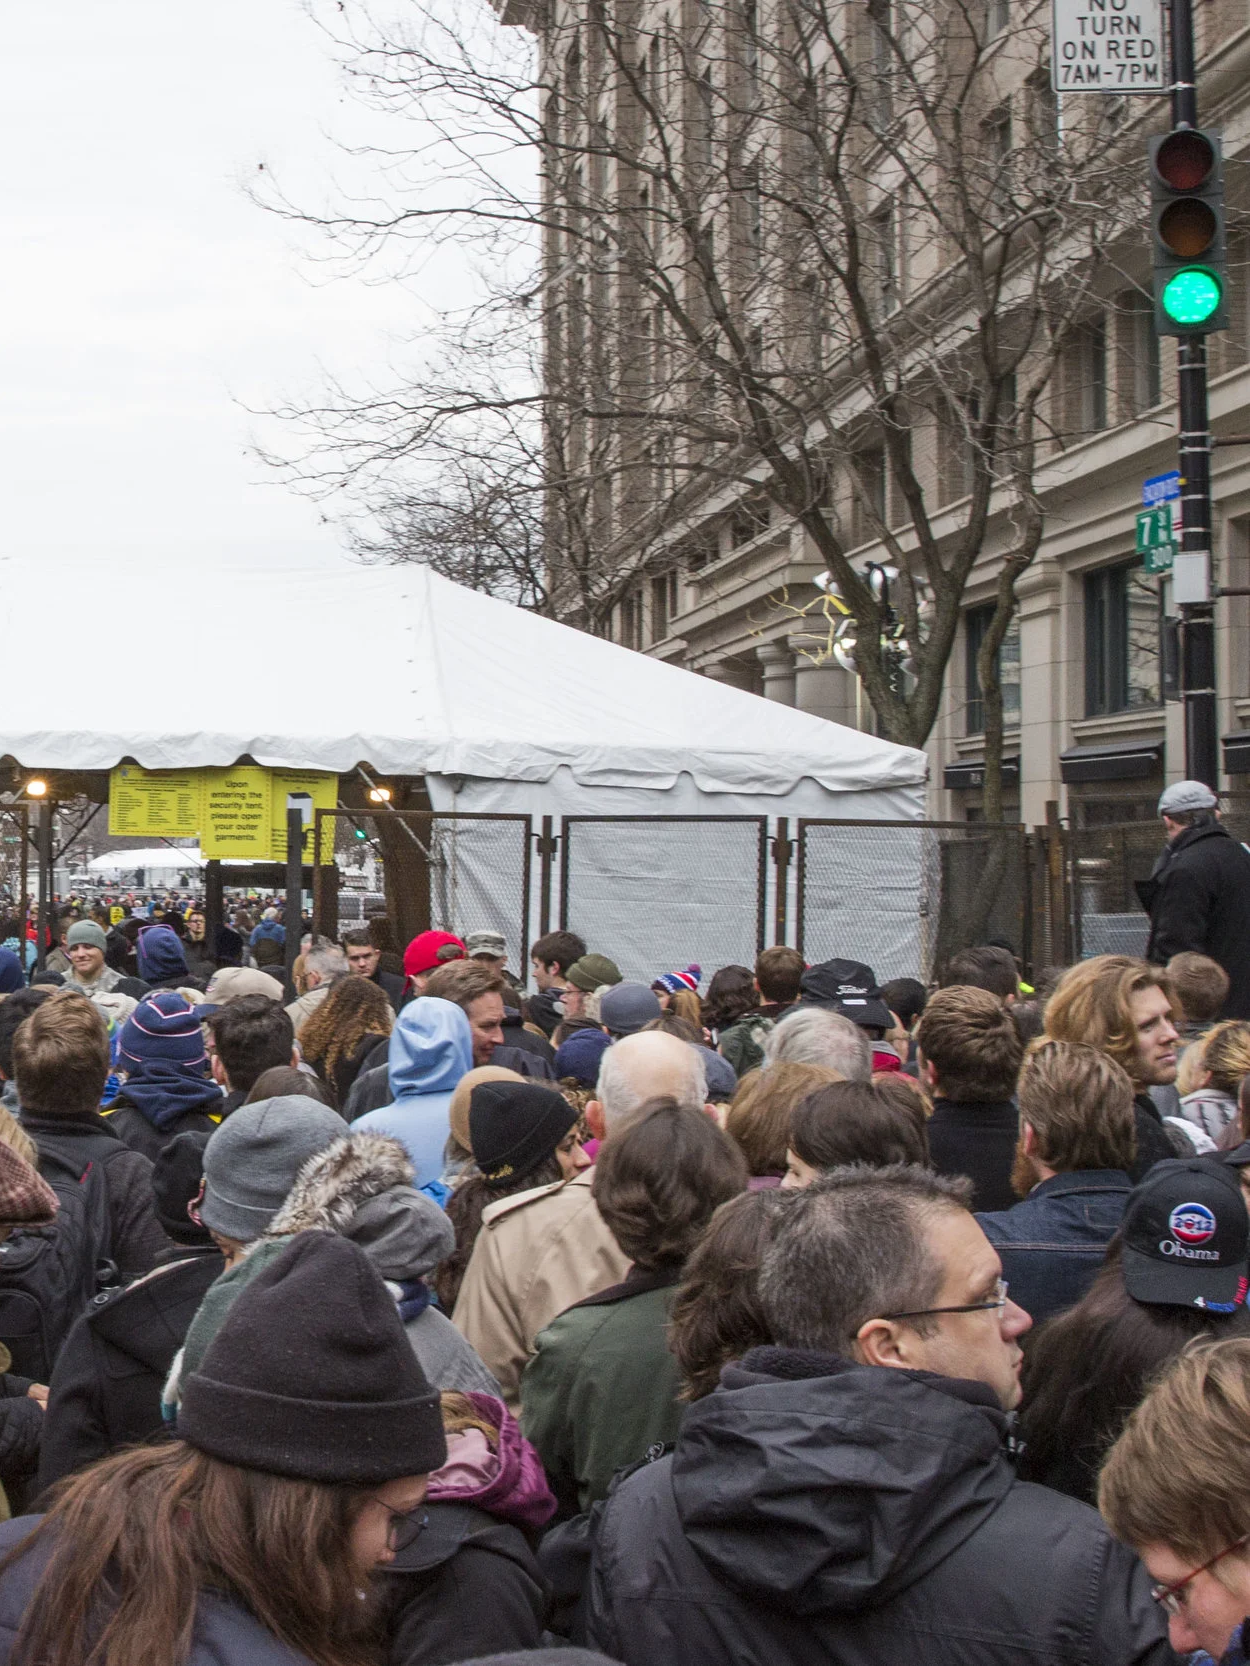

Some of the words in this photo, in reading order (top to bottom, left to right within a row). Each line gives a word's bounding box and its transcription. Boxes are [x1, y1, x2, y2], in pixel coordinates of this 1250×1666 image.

[1076, 15, 1141, 36] TURN
[1062, 40, 1096, 60] ON
[1106, 39, 1155, 59] RED
[1060, 63, 1158, 84] 7AM-7PM
[1140, 516, 1152, 546] 7
[225, 780, 249, 789] Upon
[211, 791, 246, 800] entering
[209, 801, 243, 810] security
[211, 812, 239, 820] please
[241, 813, 262, 821] open
[214, 823, 234, 831] your
[236, 823, 259, 831] outer
[214, 833, 257, 842] garments.
[1174, 1217, 1213, 1231] 2012
[1158, 1240, 1220, 1261] Obama
